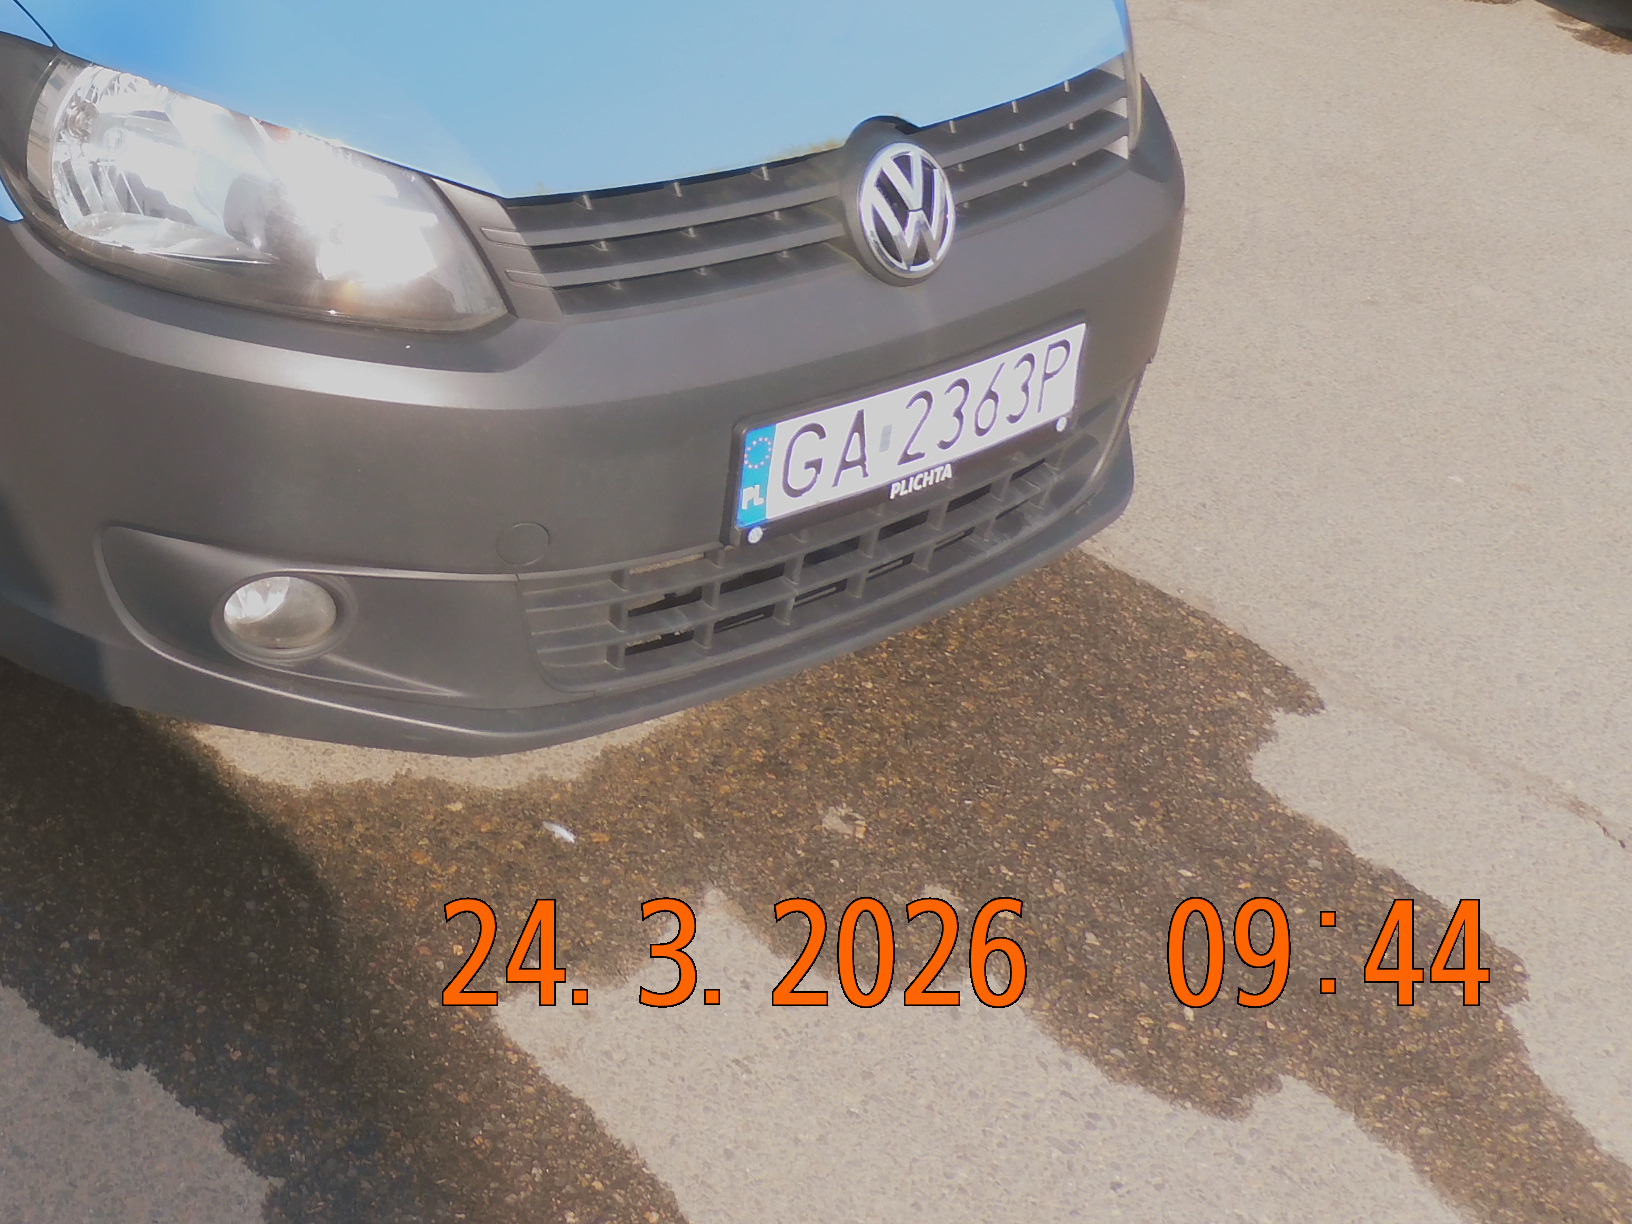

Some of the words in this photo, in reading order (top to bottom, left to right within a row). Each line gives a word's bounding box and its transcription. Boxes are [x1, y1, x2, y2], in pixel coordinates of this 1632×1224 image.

[782, 408, 870, 498] GA
[897, 338, 1072, 467] 2363P
[741, 484, 765, 510] PL
[889, 463, 953, 500] PLICHTA
